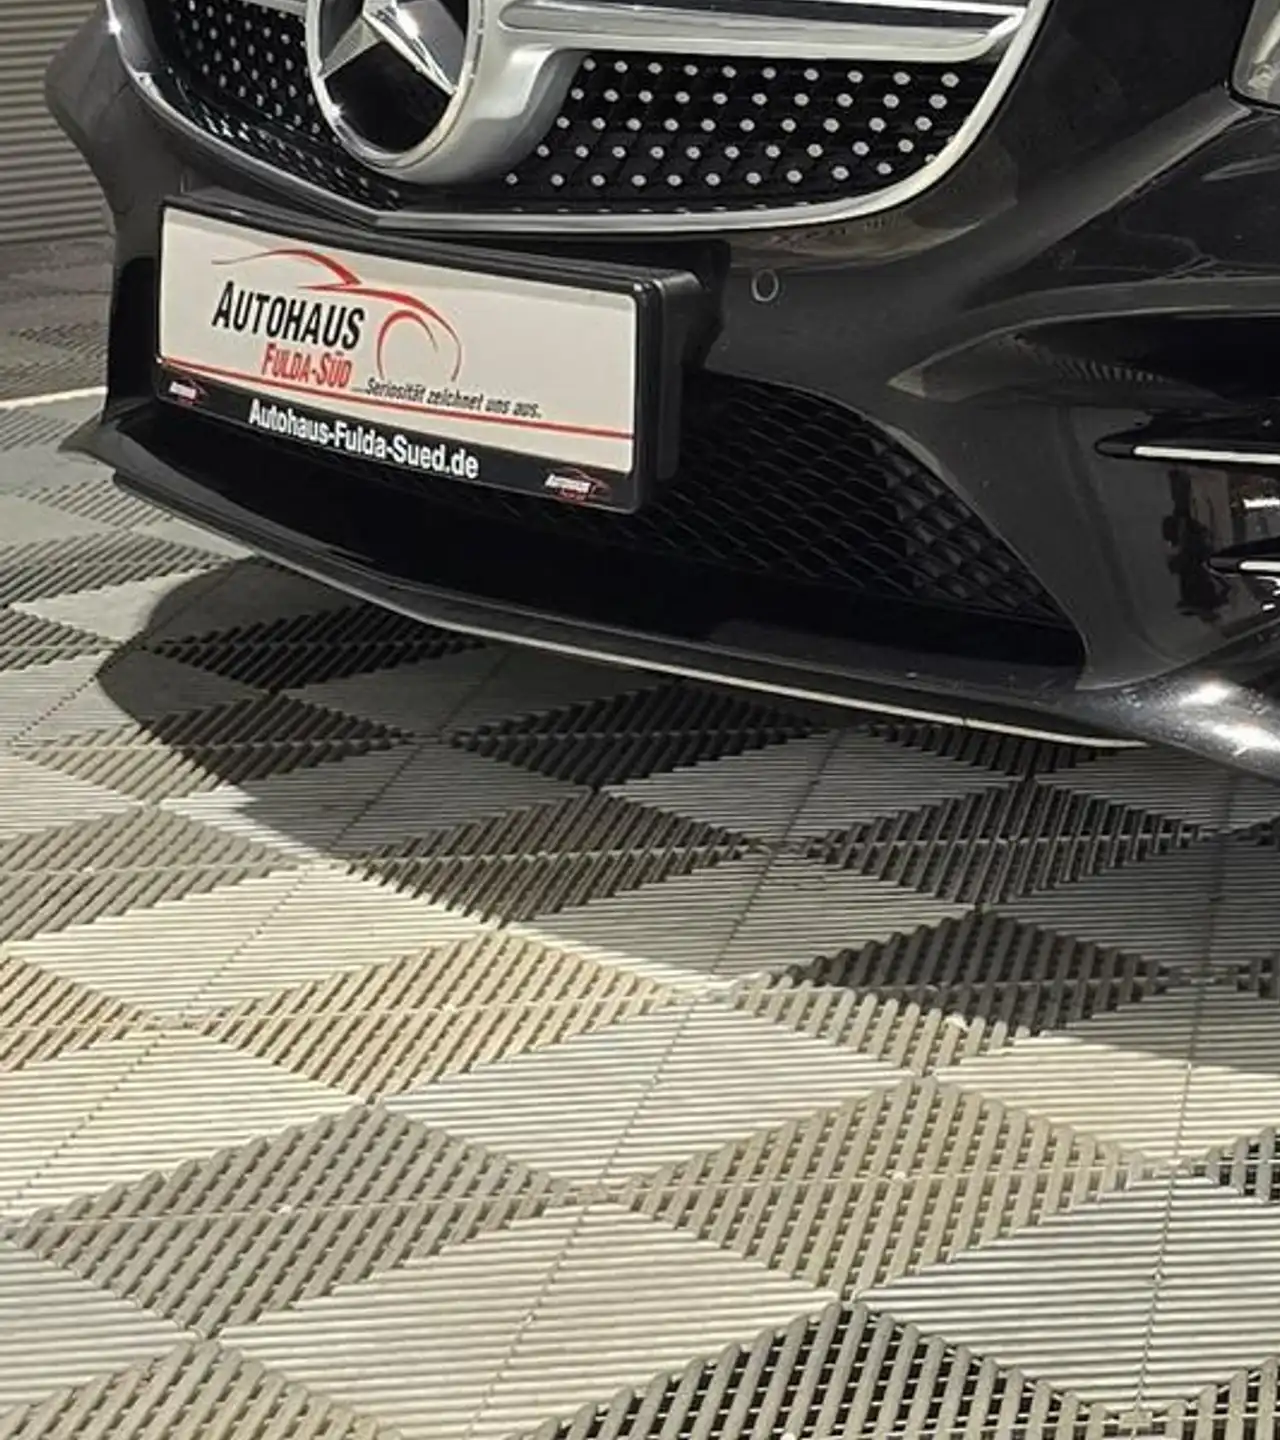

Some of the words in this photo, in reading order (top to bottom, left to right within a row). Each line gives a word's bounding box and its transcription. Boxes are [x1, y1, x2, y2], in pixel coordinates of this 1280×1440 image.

[211, 280, 366, 350] AUTOHAUS
[261, 342, 353, 388] FULDA-SÜD
[427, 387, 484, 412] zeichnet
[485, 398, 510, 415] uns
[249, 398, 480, 479] Autohaus-Fulda-Sued.de
